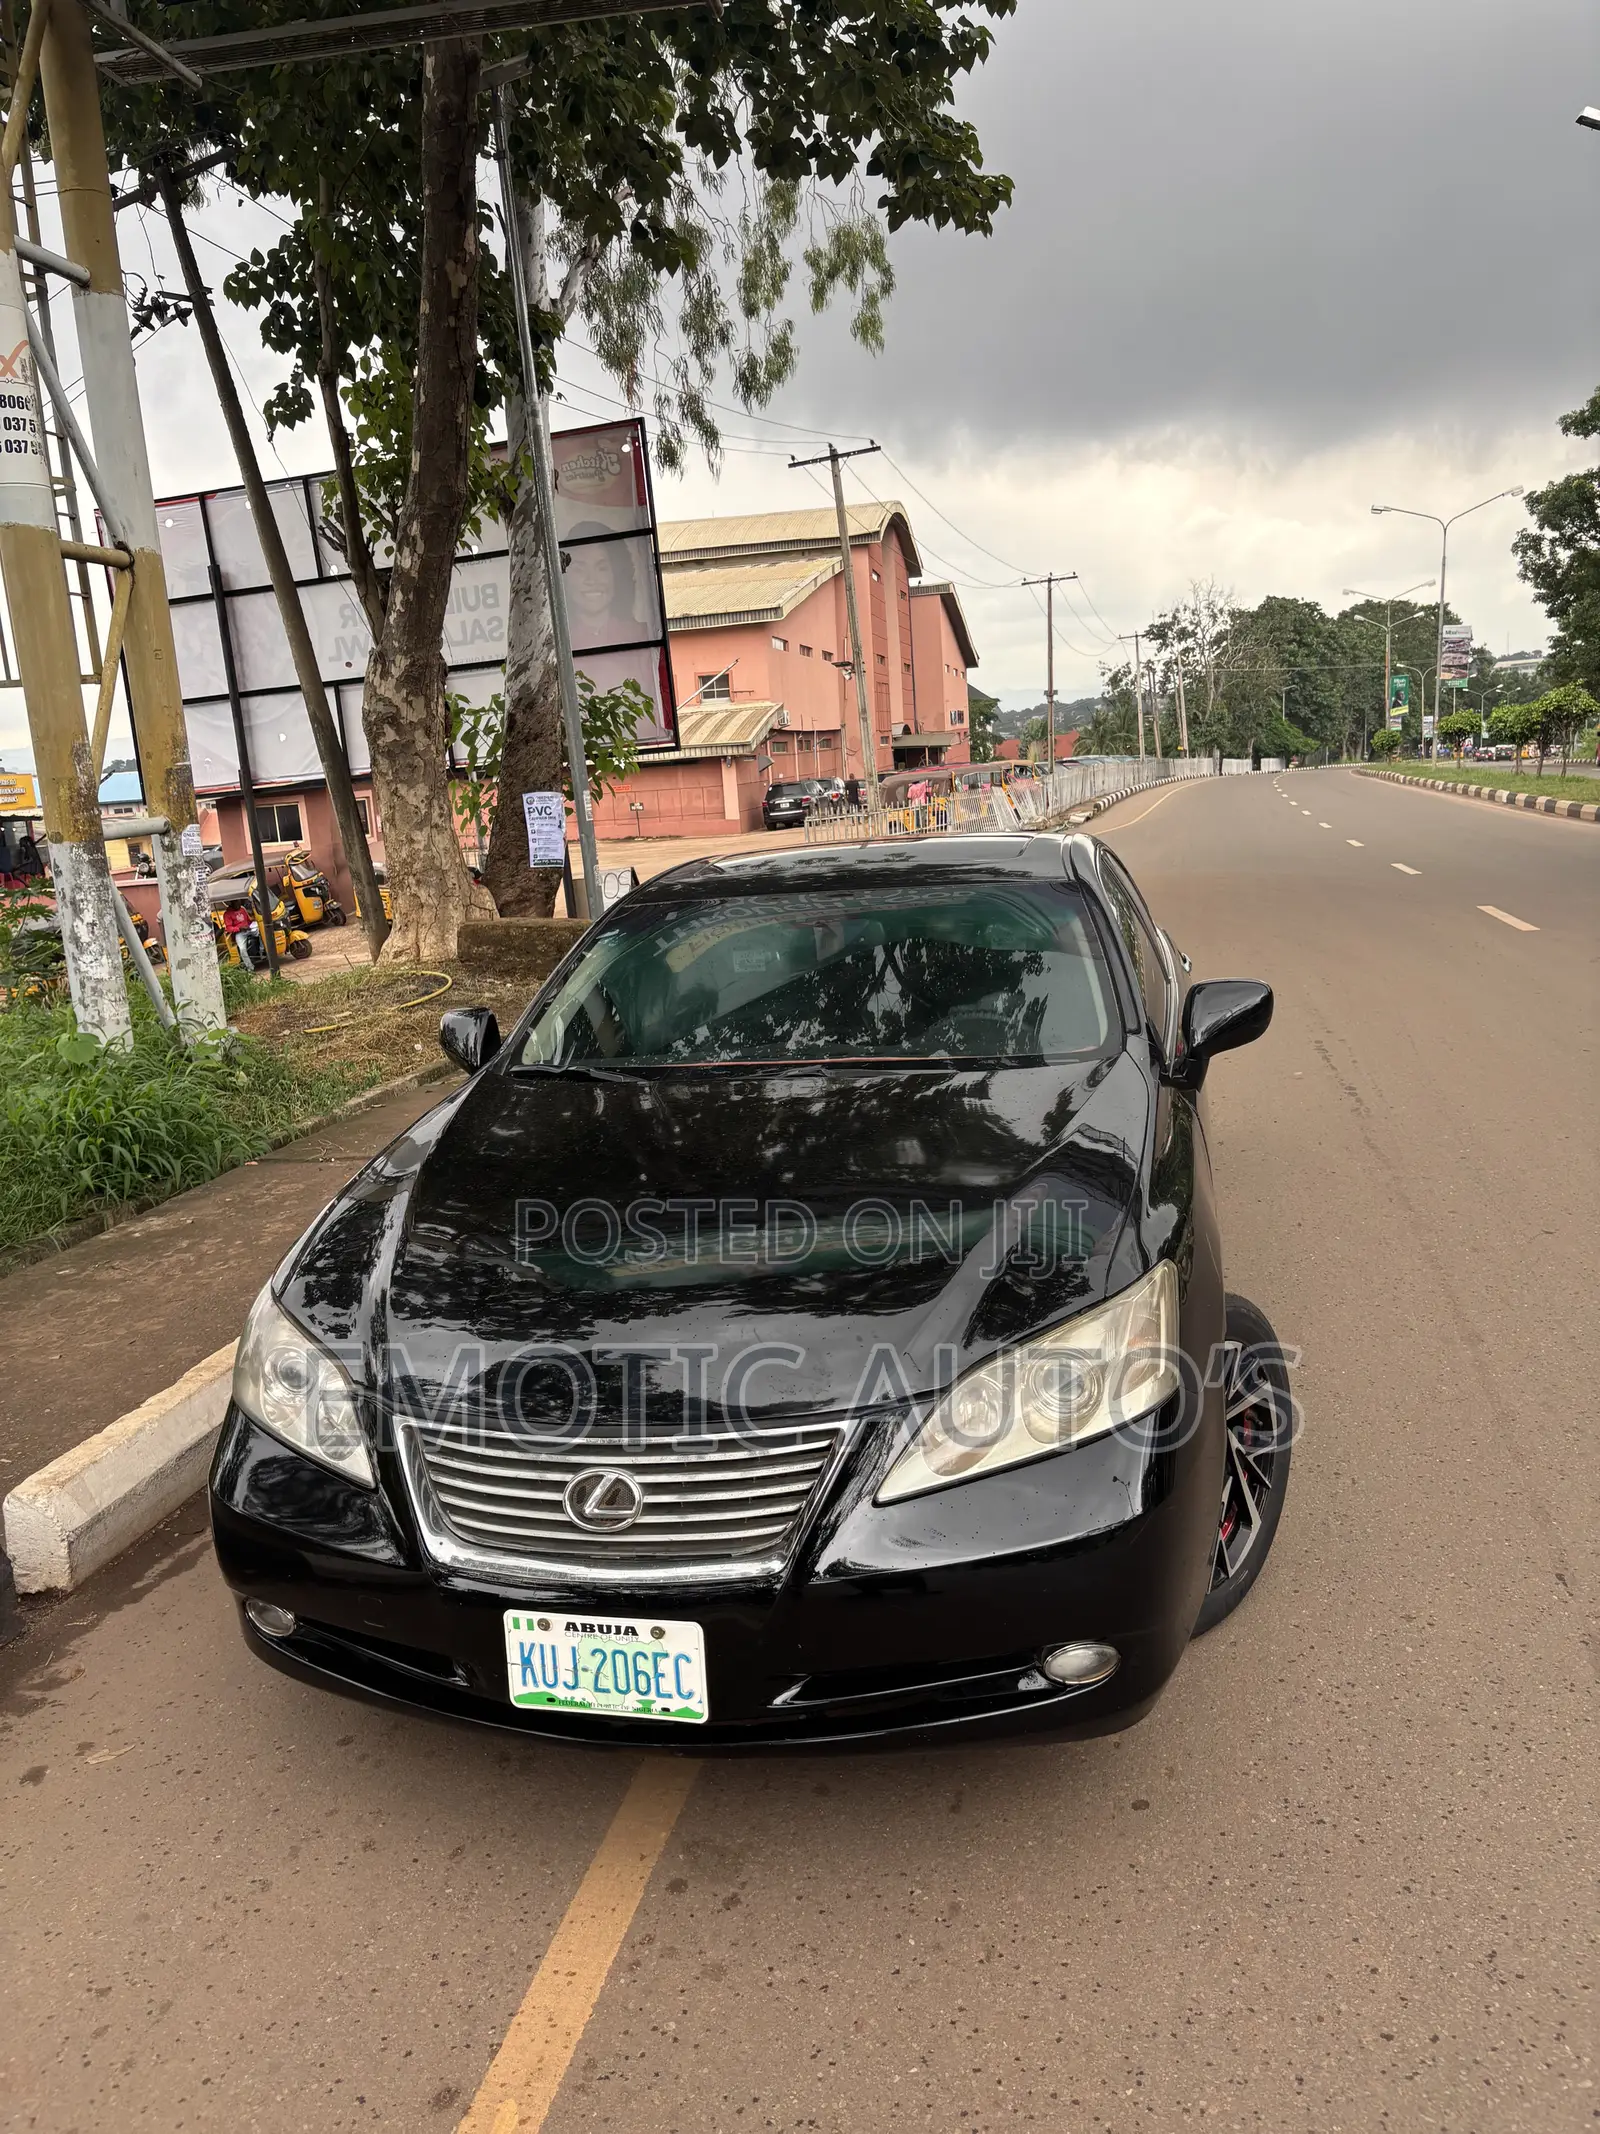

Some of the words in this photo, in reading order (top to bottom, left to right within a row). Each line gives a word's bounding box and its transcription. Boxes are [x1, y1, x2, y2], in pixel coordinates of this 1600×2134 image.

[3, 416, 26, 432] 037
[4, 438, 28, 454] 037
[528, 805, 553, 817] PVC
[564, 1621, 640, 1637] ABUJA
[564, 1631, 600, 1641] CENTRE
[615, 1635, 640, 1643] UNITY
[518, 1641, 694, 1701] KUJ-206EC
[558, 1699, 588, 1709] FEDERAL
